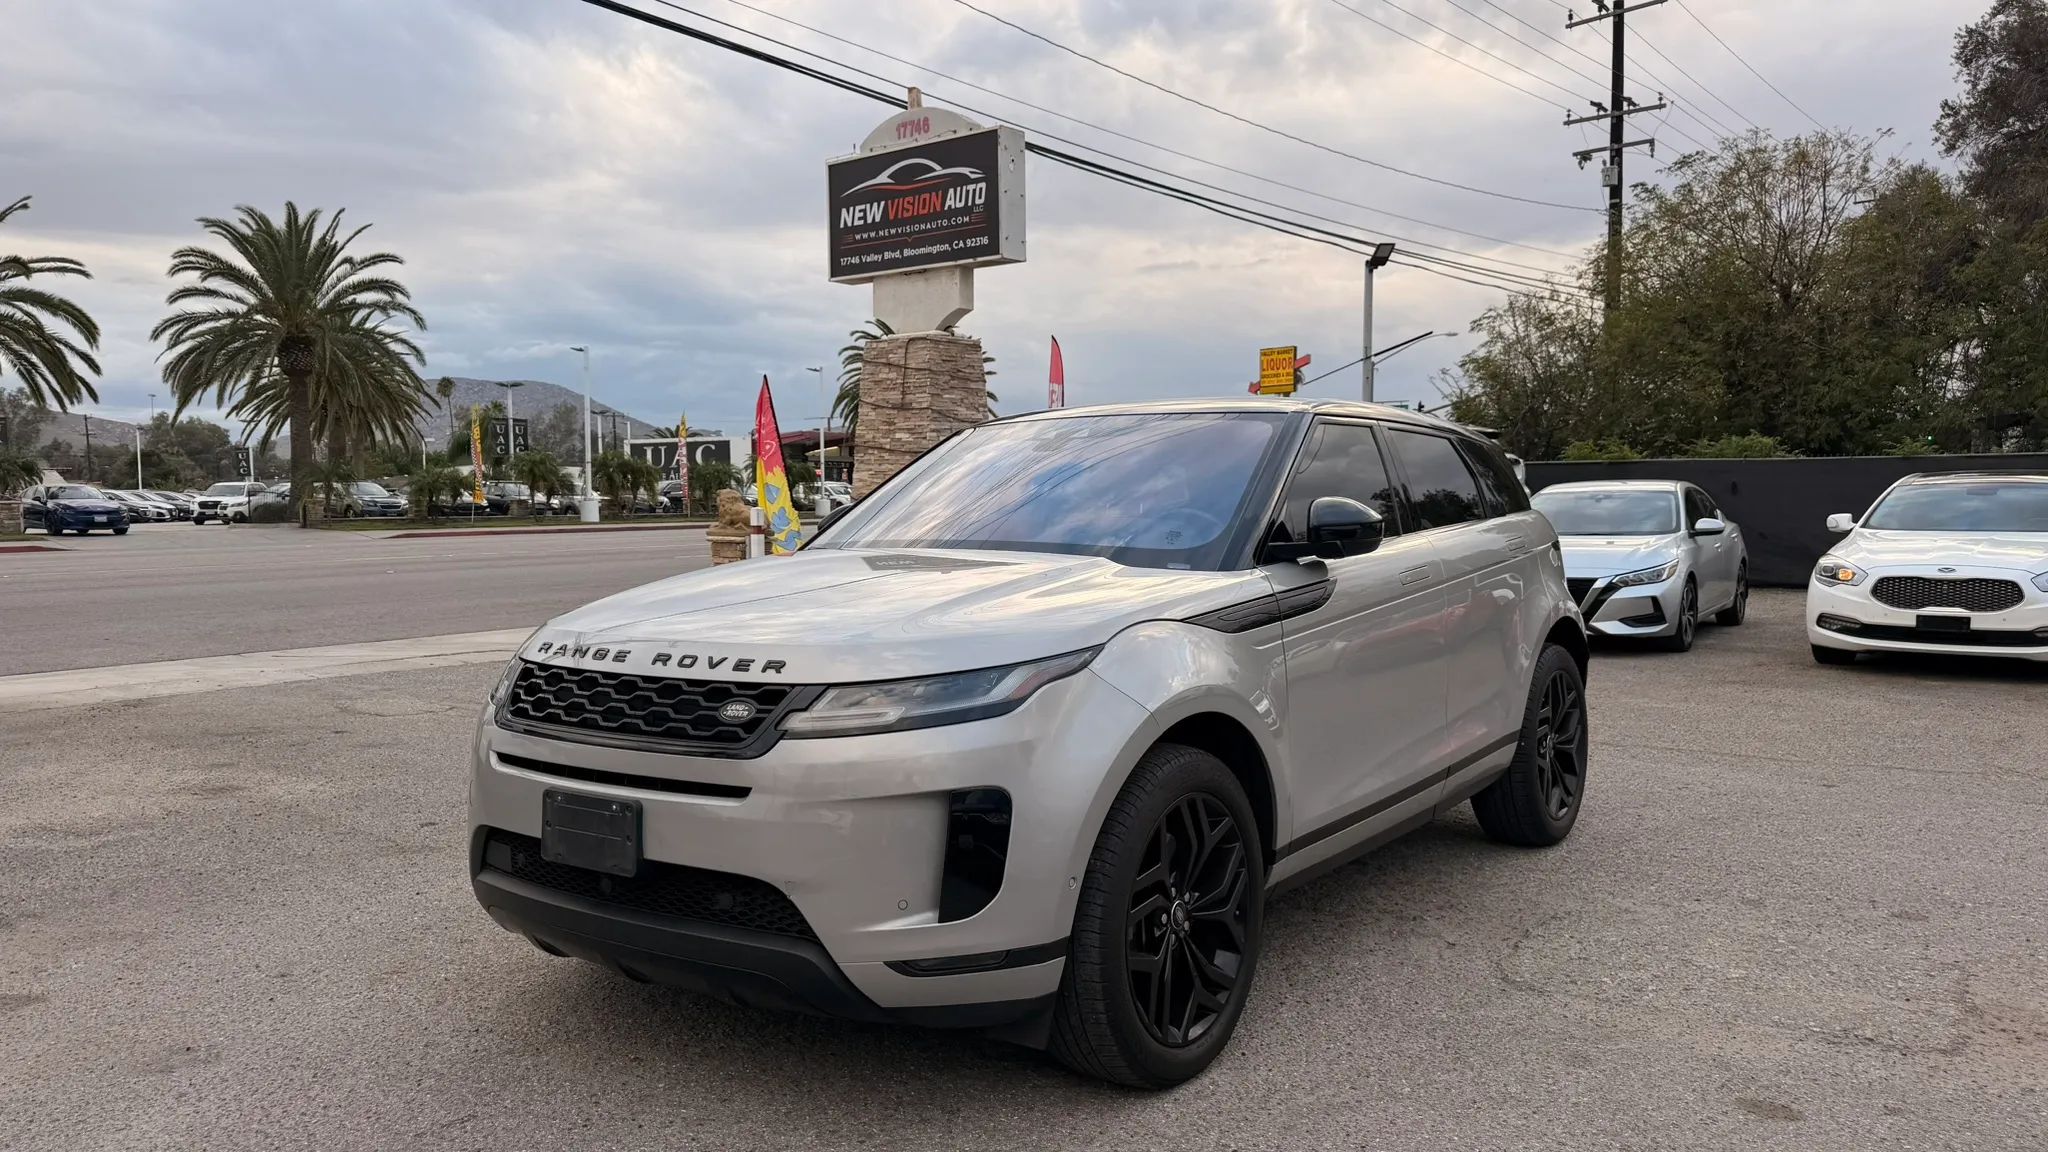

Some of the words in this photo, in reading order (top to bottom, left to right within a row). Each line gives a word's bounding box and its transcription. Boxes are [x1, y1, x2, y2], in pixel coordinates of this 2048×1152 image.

[896, 116, 930, 140] 17746
[840, 201, 885, 229] NEW
[888, 190, 943, 221] VISION
[944, 182, 987, 211] AUTO
[973, 205, 984, 213] LLC
[854, 215, 970, 241] WWW.NEWVISIONAUTO.COM
[840, 256, 860, 266] 17746
[861, 253, 883, 264] Valley
[884, 249, 902, 260] Blvd,
[903, 243, 952, 257] Bloomington,
[953, 239, 965, 249] CA
[966, 236, 989, 248] 92316
[537, 641, 631, 663] RANGE
[651, 652, 787, 674] ROVER
